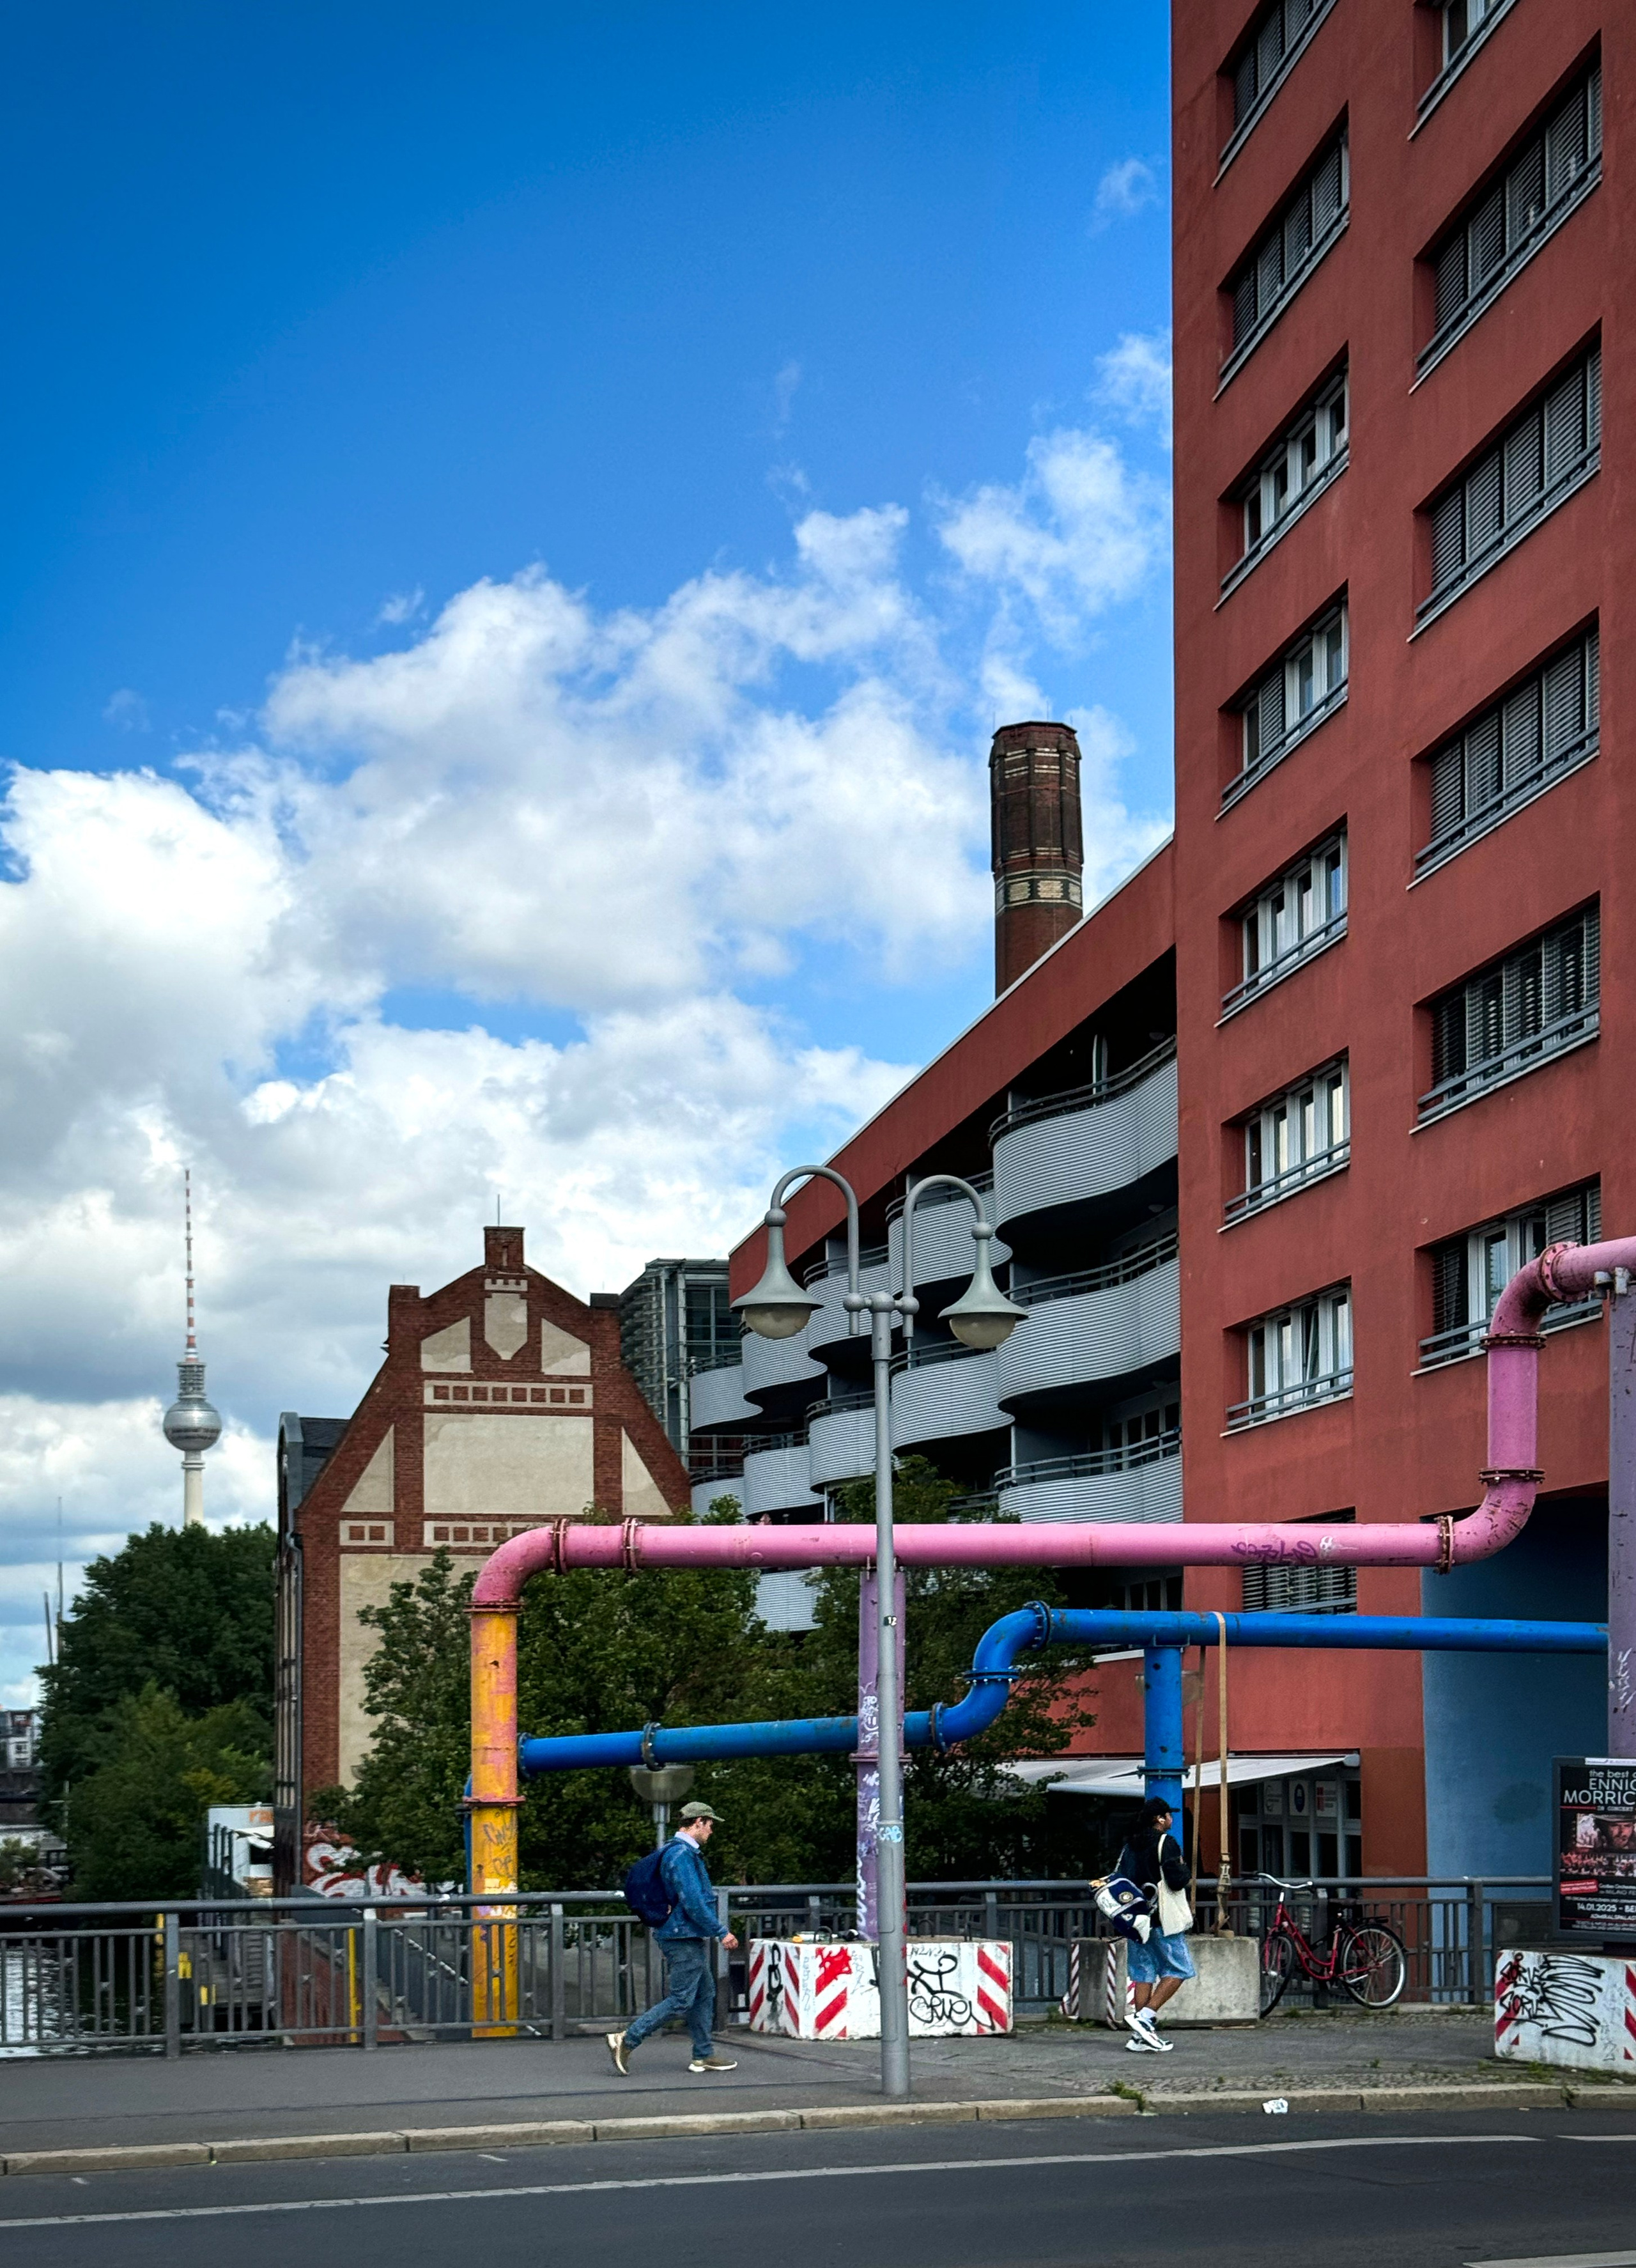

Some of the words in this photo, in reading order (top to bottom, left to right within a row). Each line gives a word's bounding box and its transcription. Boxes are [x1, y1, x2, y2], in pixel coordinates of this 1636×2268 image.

[888, 1617, 897, 1626] 12
[1589, 1769, 1605, 1778] the
[1607, 1769, 1629, 1778] best
[1577, 1903, 1617, 1913] 14.01.2025
